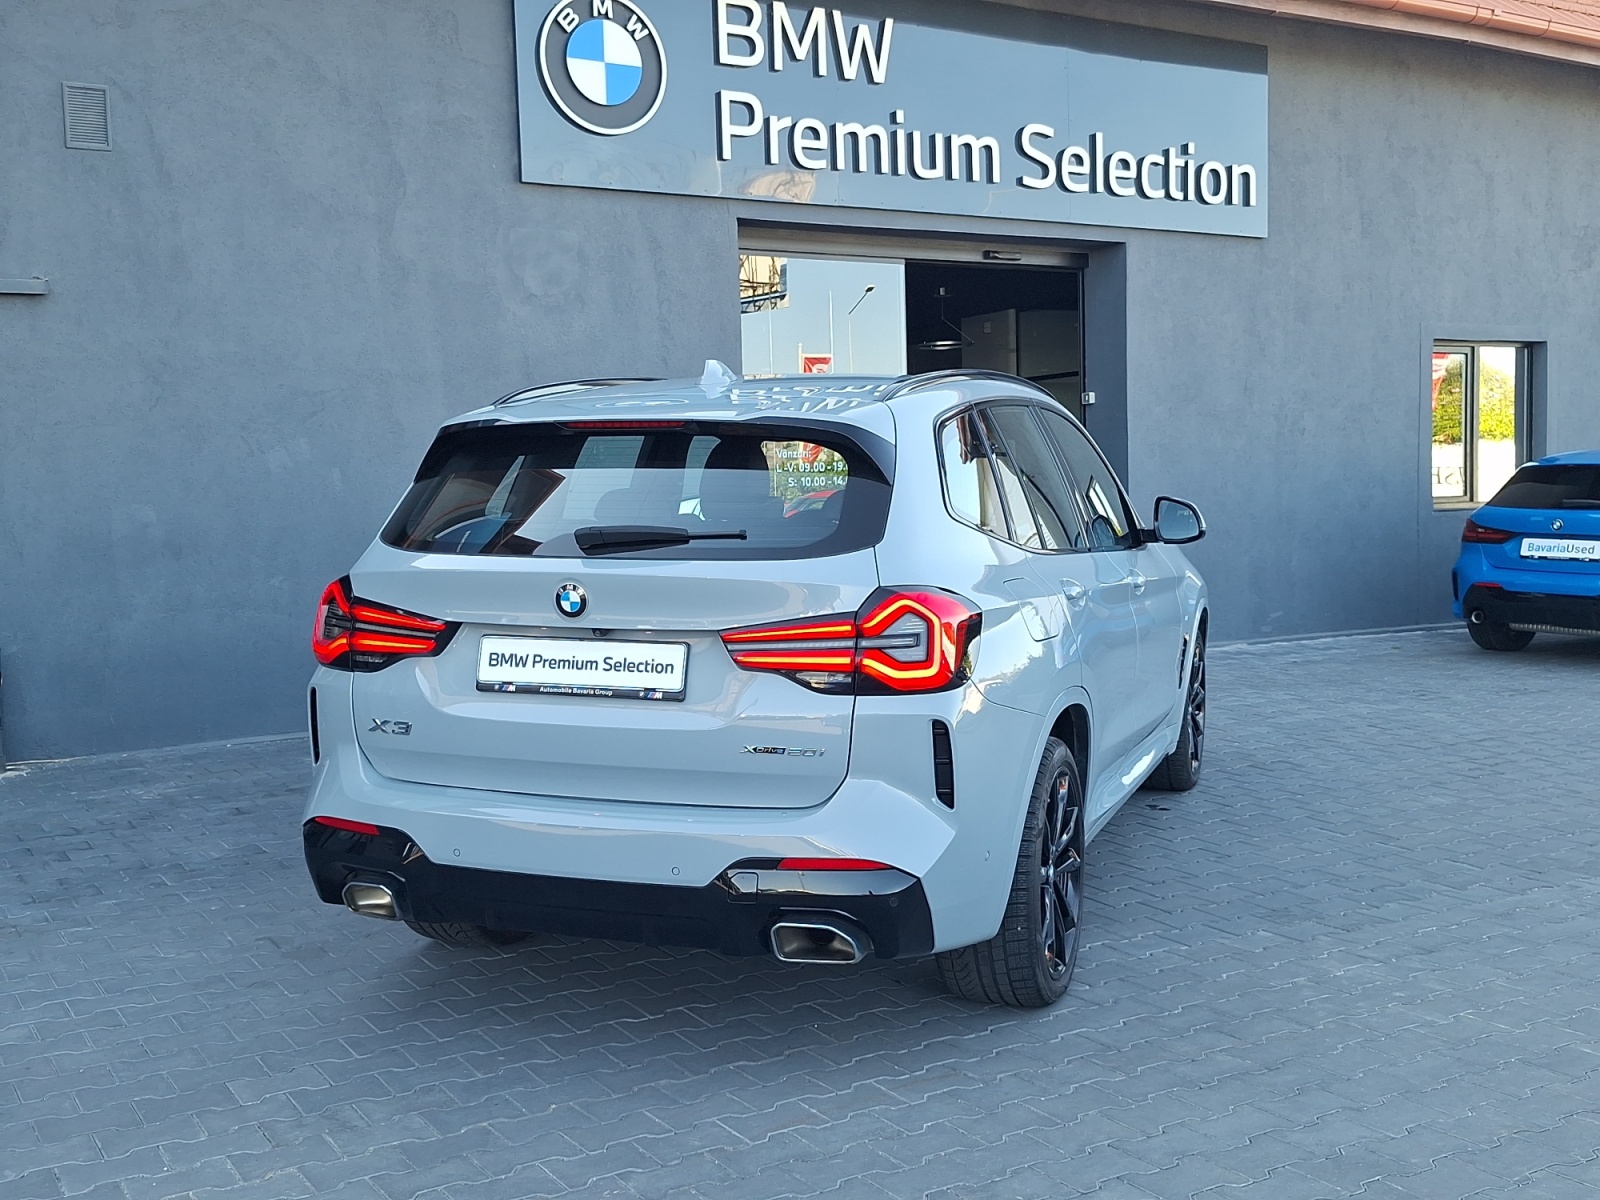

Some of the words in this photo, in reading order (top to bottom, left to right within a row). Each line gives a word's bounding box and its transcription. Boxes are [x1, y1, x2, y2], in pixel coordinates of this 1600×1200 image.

[556, 0, 650, 41] BMW
[715, 0, 895, 84] BMW
[717, 89, 1000, 184] Premium
[1018, 122, 1257, 207] Selection
[799, 462, 826, 472] 09.00
[788, 477, 798, 486] S:
[801, 477, 826, 486] 10.00
[1527, 543, 1596, 554] BavariaUsed
[488, 652, 529, 668] BMW
[532, 654, 599, 671] Premium
[602, 656, 675, 675] Selection
[595, 688, 613, 697] Group
[368, 718, 413, 736] X3
